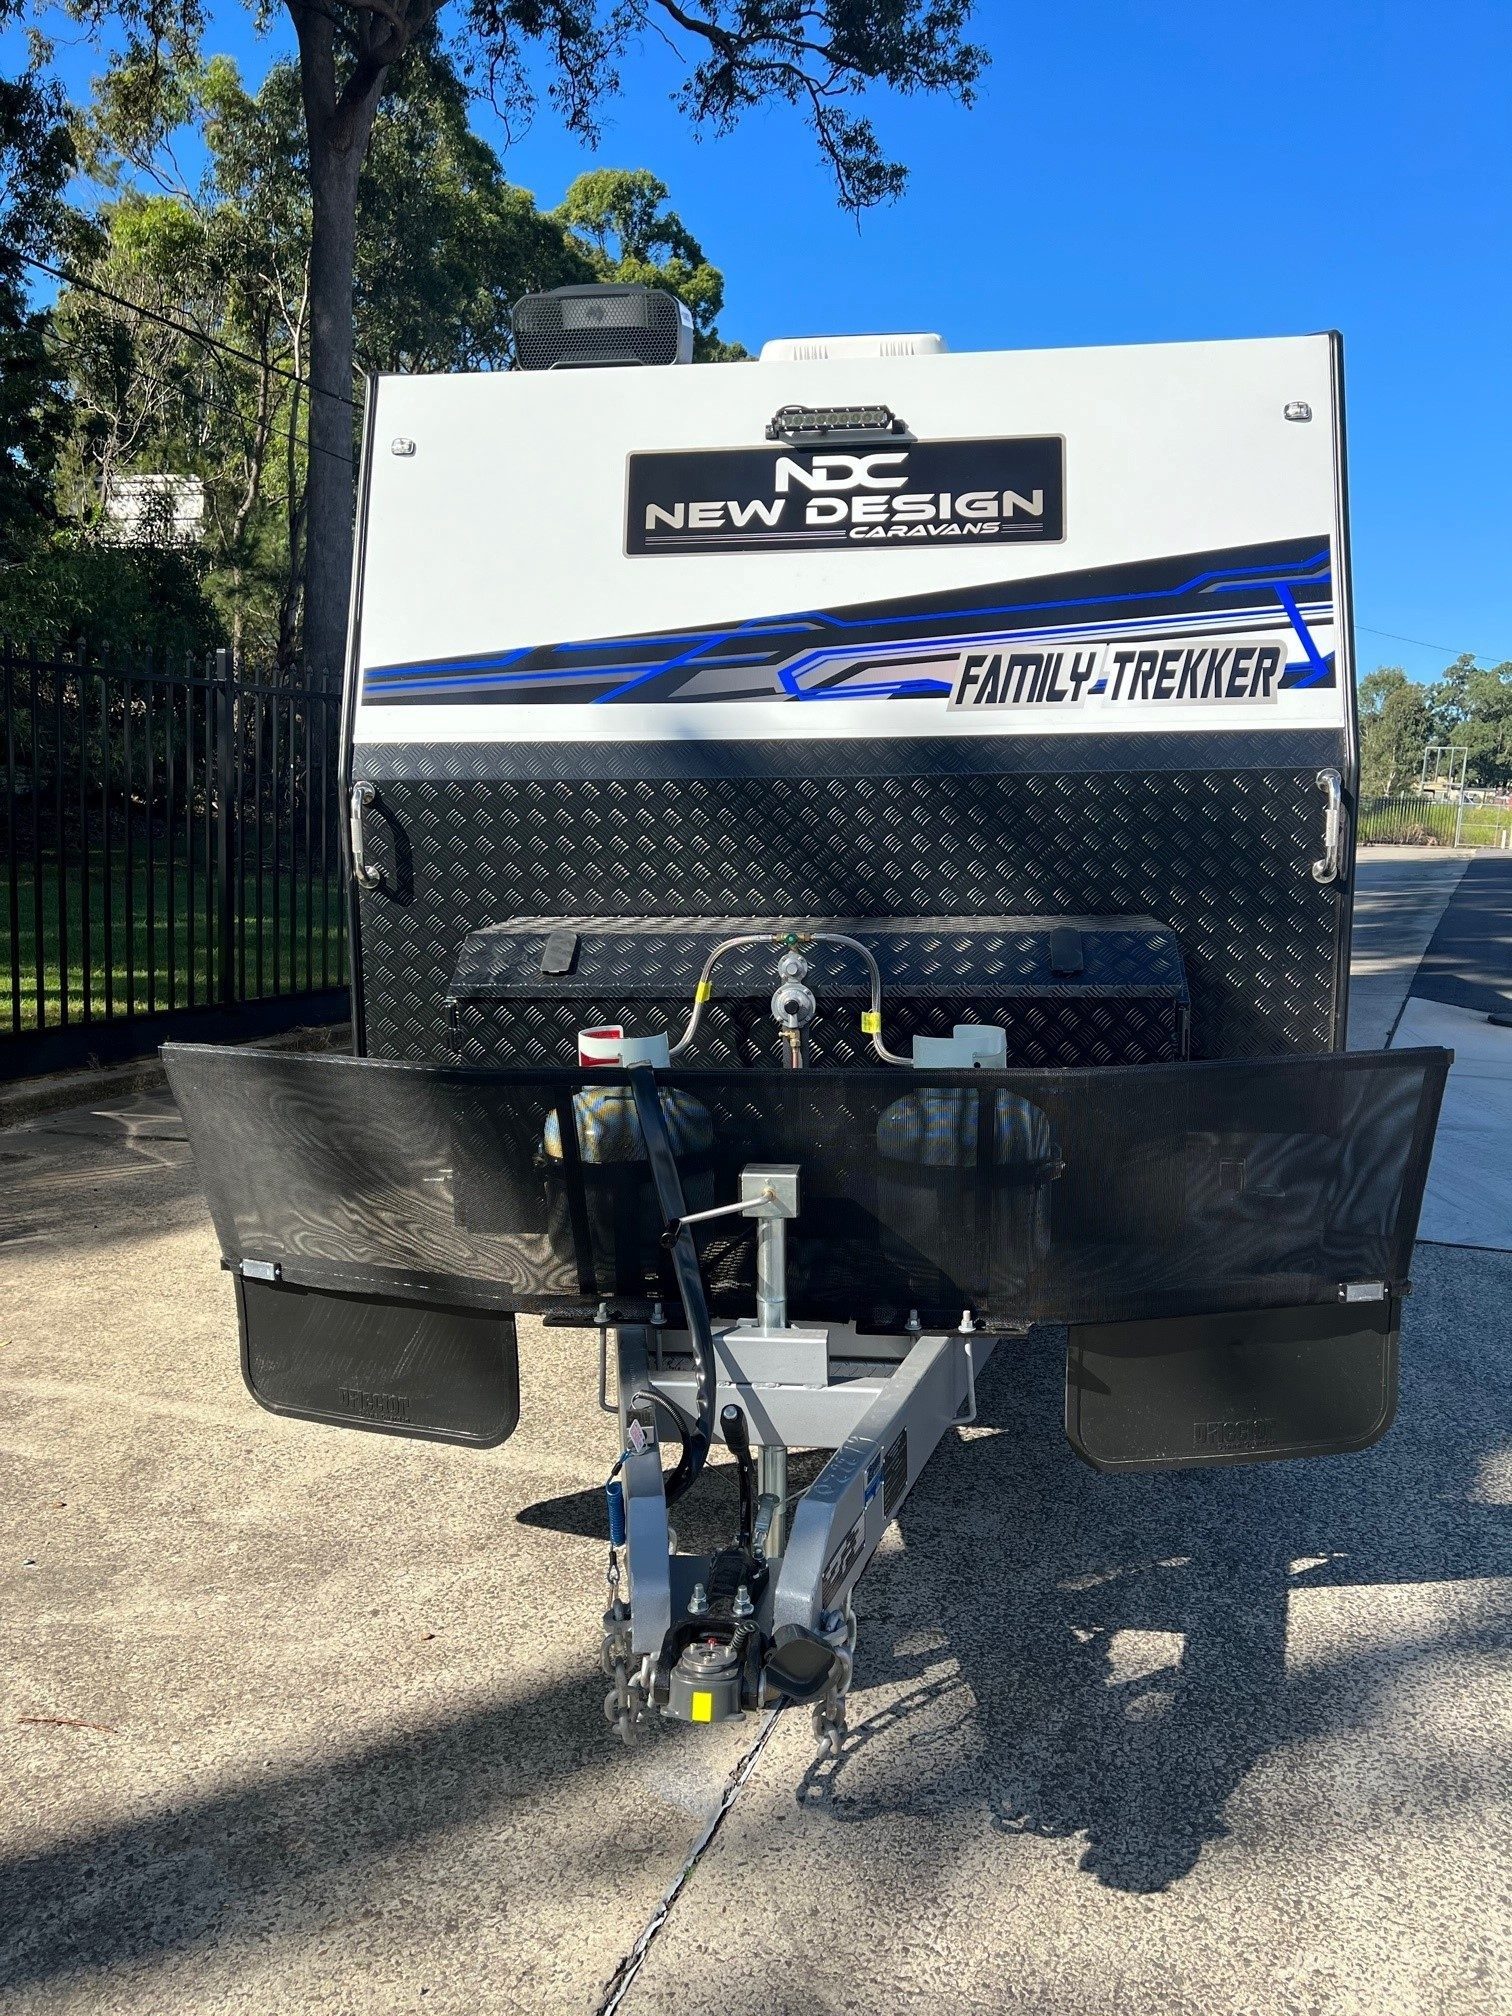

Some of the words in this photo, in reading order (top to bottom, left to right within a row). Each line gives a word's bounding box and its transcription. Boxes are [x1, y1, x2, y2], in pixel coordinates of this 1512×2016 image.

[775, 453, 909, 492] NDC
[645, 498, 786, 530] NEW
[805, 489, 1044, 524] DESIGN
[849, 521, 1002, 539] CARAVANS
[955, 651, 1097, 705] FAMILY
[1109, 646, 1281, 701] TREKKER
